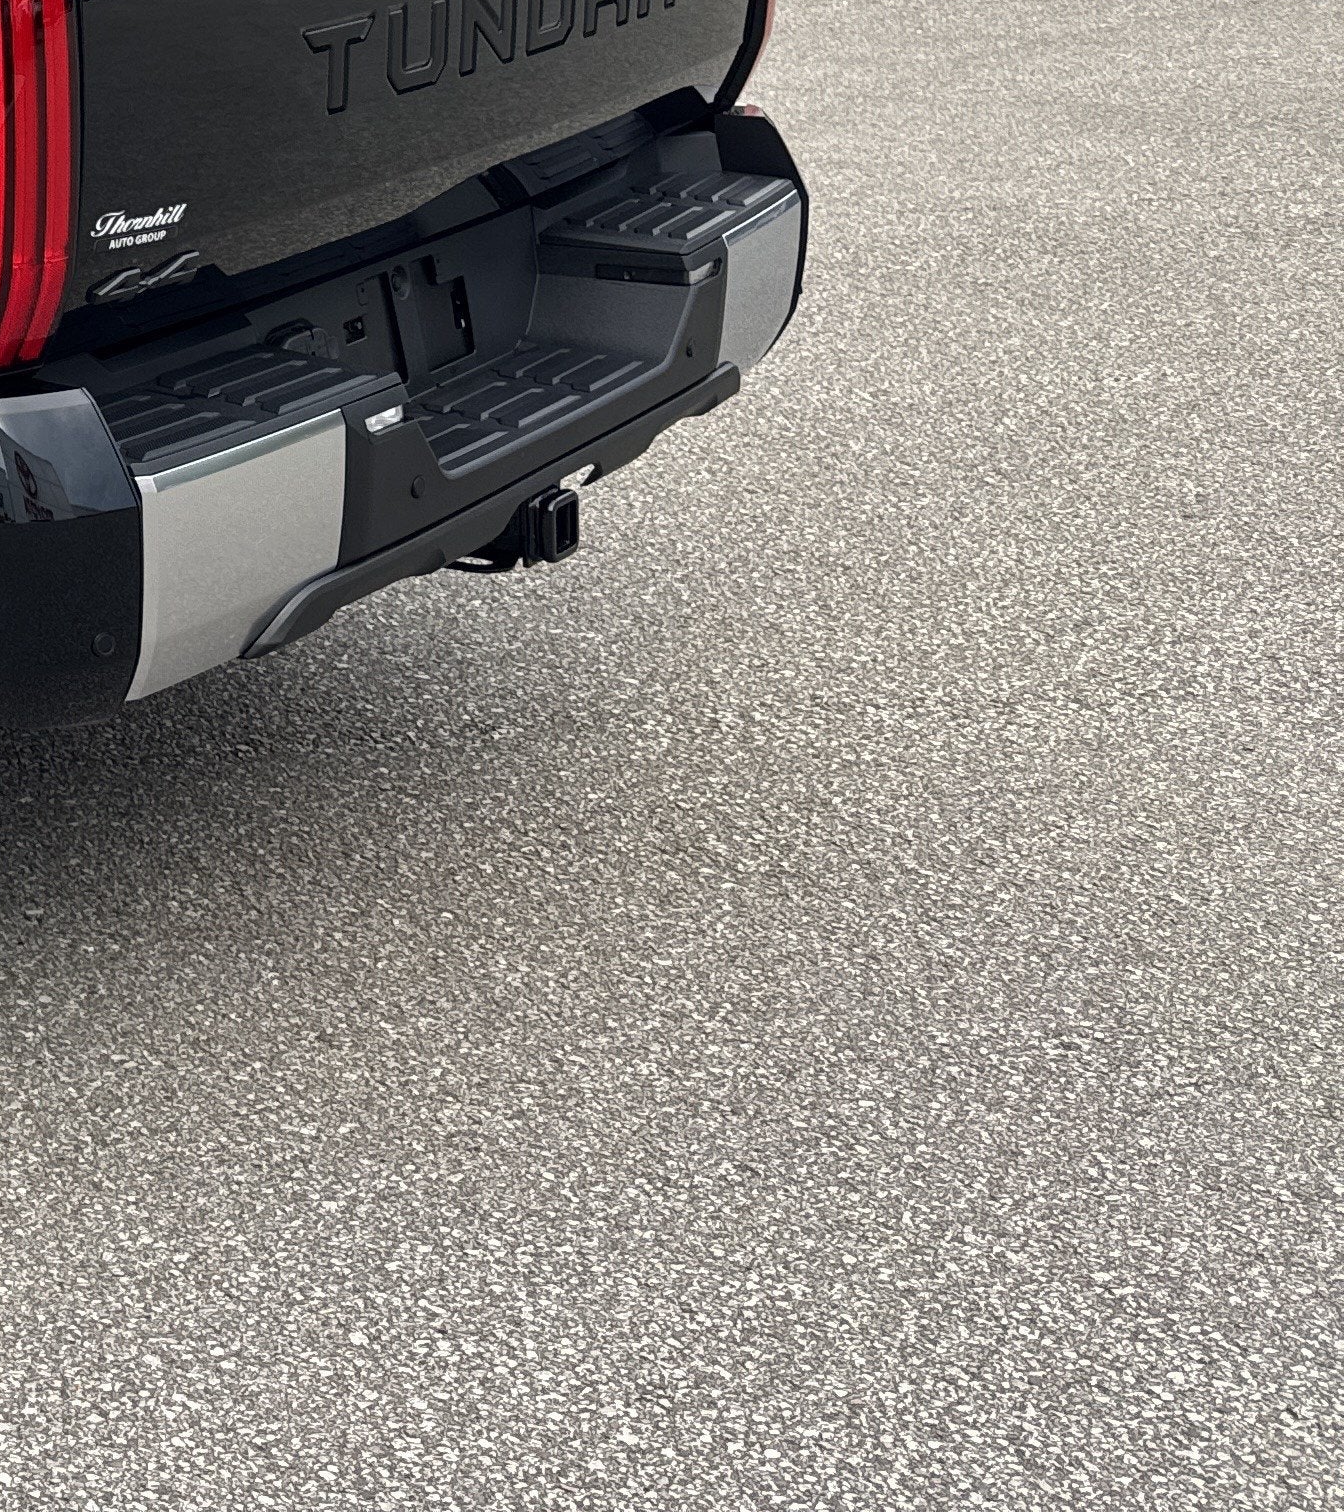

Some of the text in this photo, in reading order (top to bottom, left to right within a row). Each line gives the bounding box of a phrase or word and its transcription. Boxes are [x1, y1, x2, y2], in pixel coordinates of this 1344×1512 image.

[90, 203, 187, 238] Thornhill
[108, 230, 167, 250] AUTO GROUP
